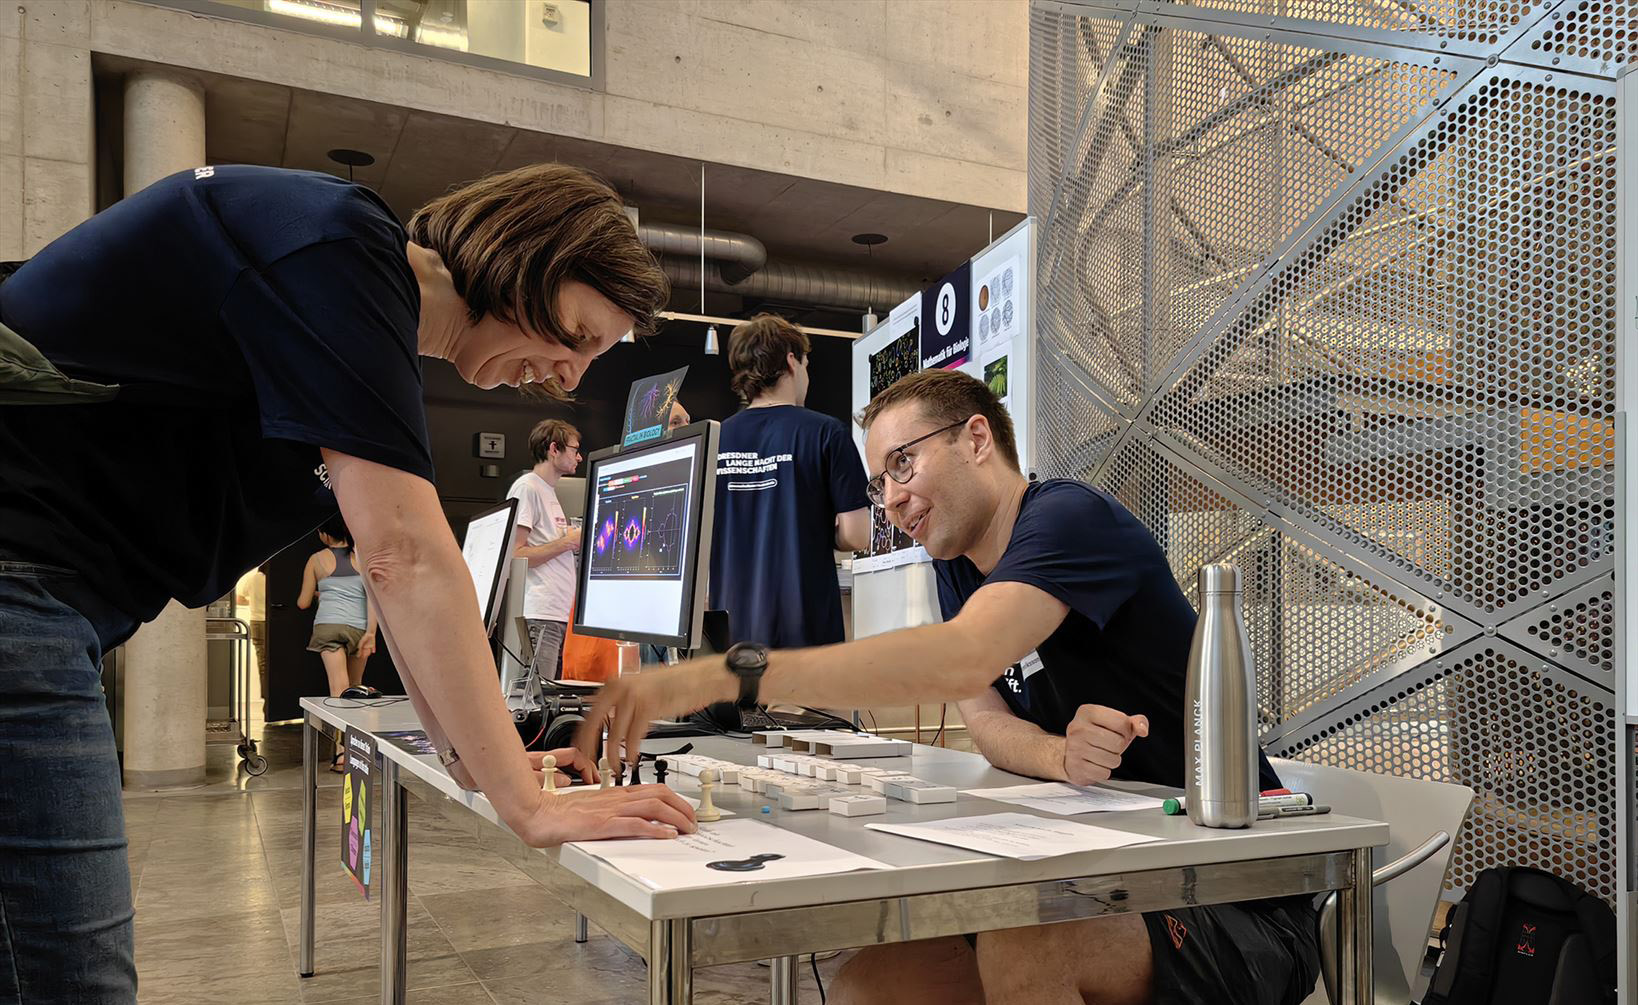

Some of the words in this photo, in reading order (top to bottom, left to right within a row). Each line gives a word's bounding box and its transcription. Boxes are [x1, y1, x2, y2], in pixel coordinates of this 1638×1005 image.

[942, 293, 949, 326] 8
[717, 452, 758, 461] DRESDNER
[726, 459, 754, 467] LANGE
[754, 455, 776, 466] NACHT
[776, 454, 793, 462] DER
[1193, 699, 1204, 753] PLANCK
[1194, 756, 1204, 787] MAX
